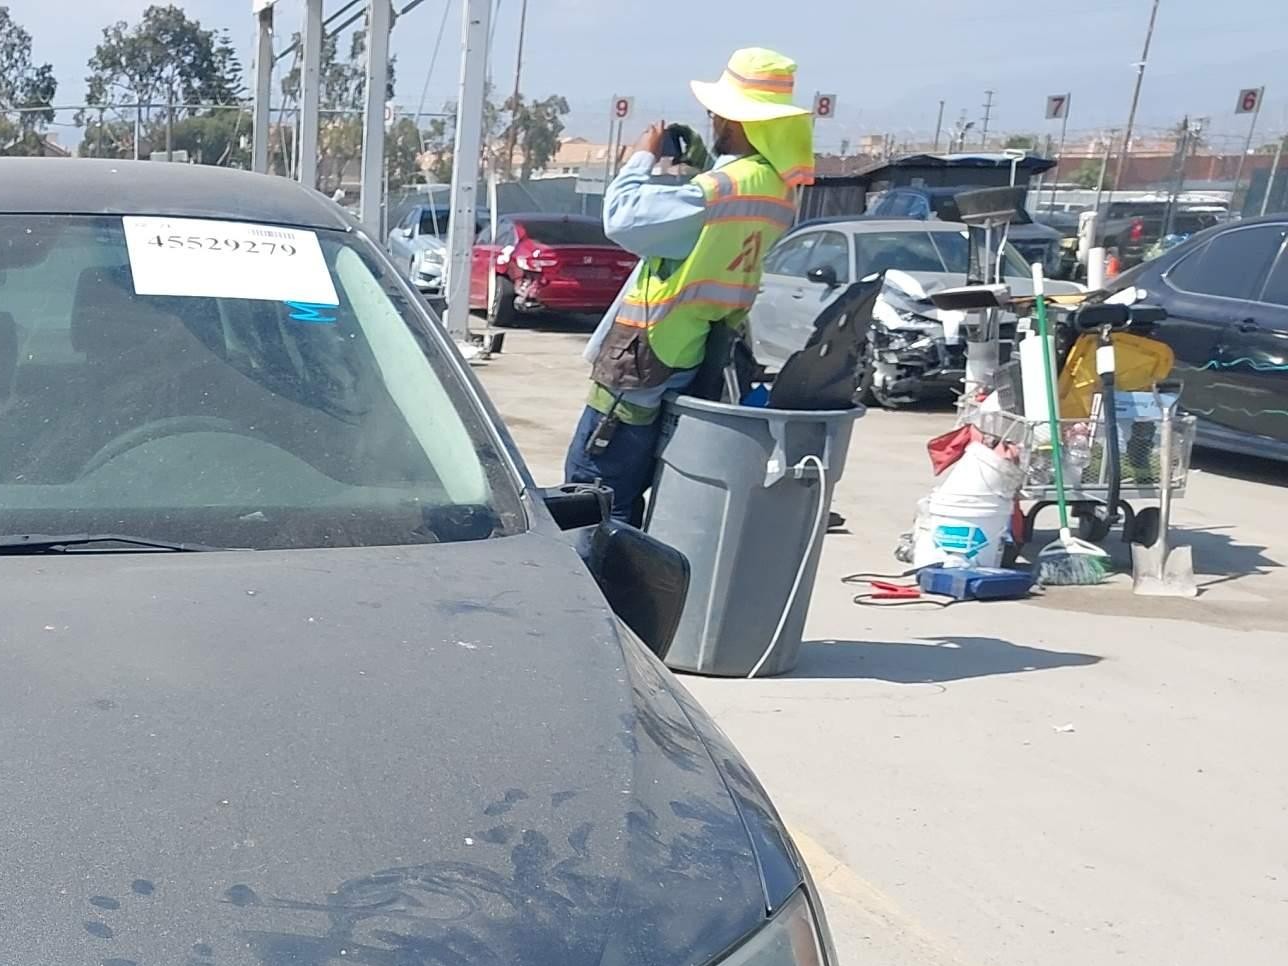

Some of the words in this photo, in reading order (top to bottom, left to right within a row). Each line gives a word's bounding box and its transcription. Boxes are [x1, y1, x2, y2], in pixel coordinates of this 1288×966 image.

[616, 99, 628, 118] 9
[817, 96, 830, 116] 8
[1052, 97, 1065, 117] 7
[1242, 91, 1257, 111] 6
[148, 235, 297, 256] 45529279
